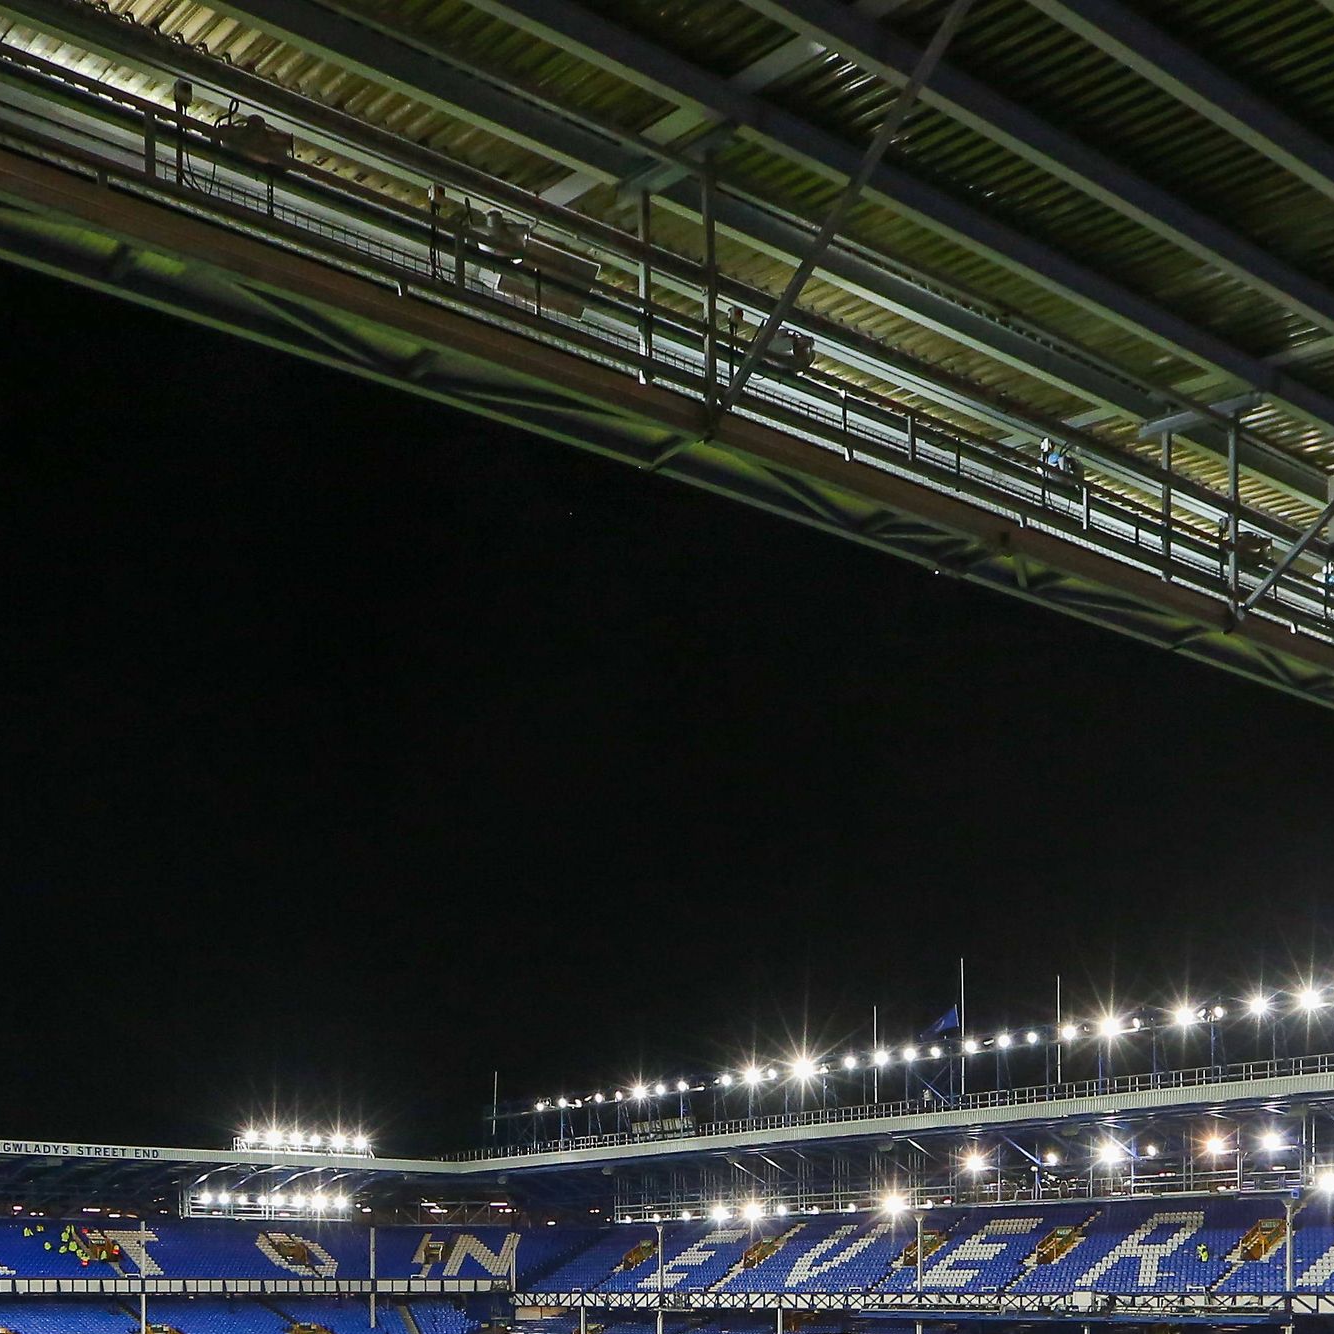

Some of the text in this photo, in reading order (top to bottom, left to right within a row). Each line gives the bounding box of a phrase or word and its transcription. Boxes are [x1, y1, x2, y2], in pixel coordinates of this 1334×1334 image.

[3, 1142, 69, 1155] GWLADYS
[77, 1145, 128, 1158] STREET
[134, 1147, 160, 1159] END
